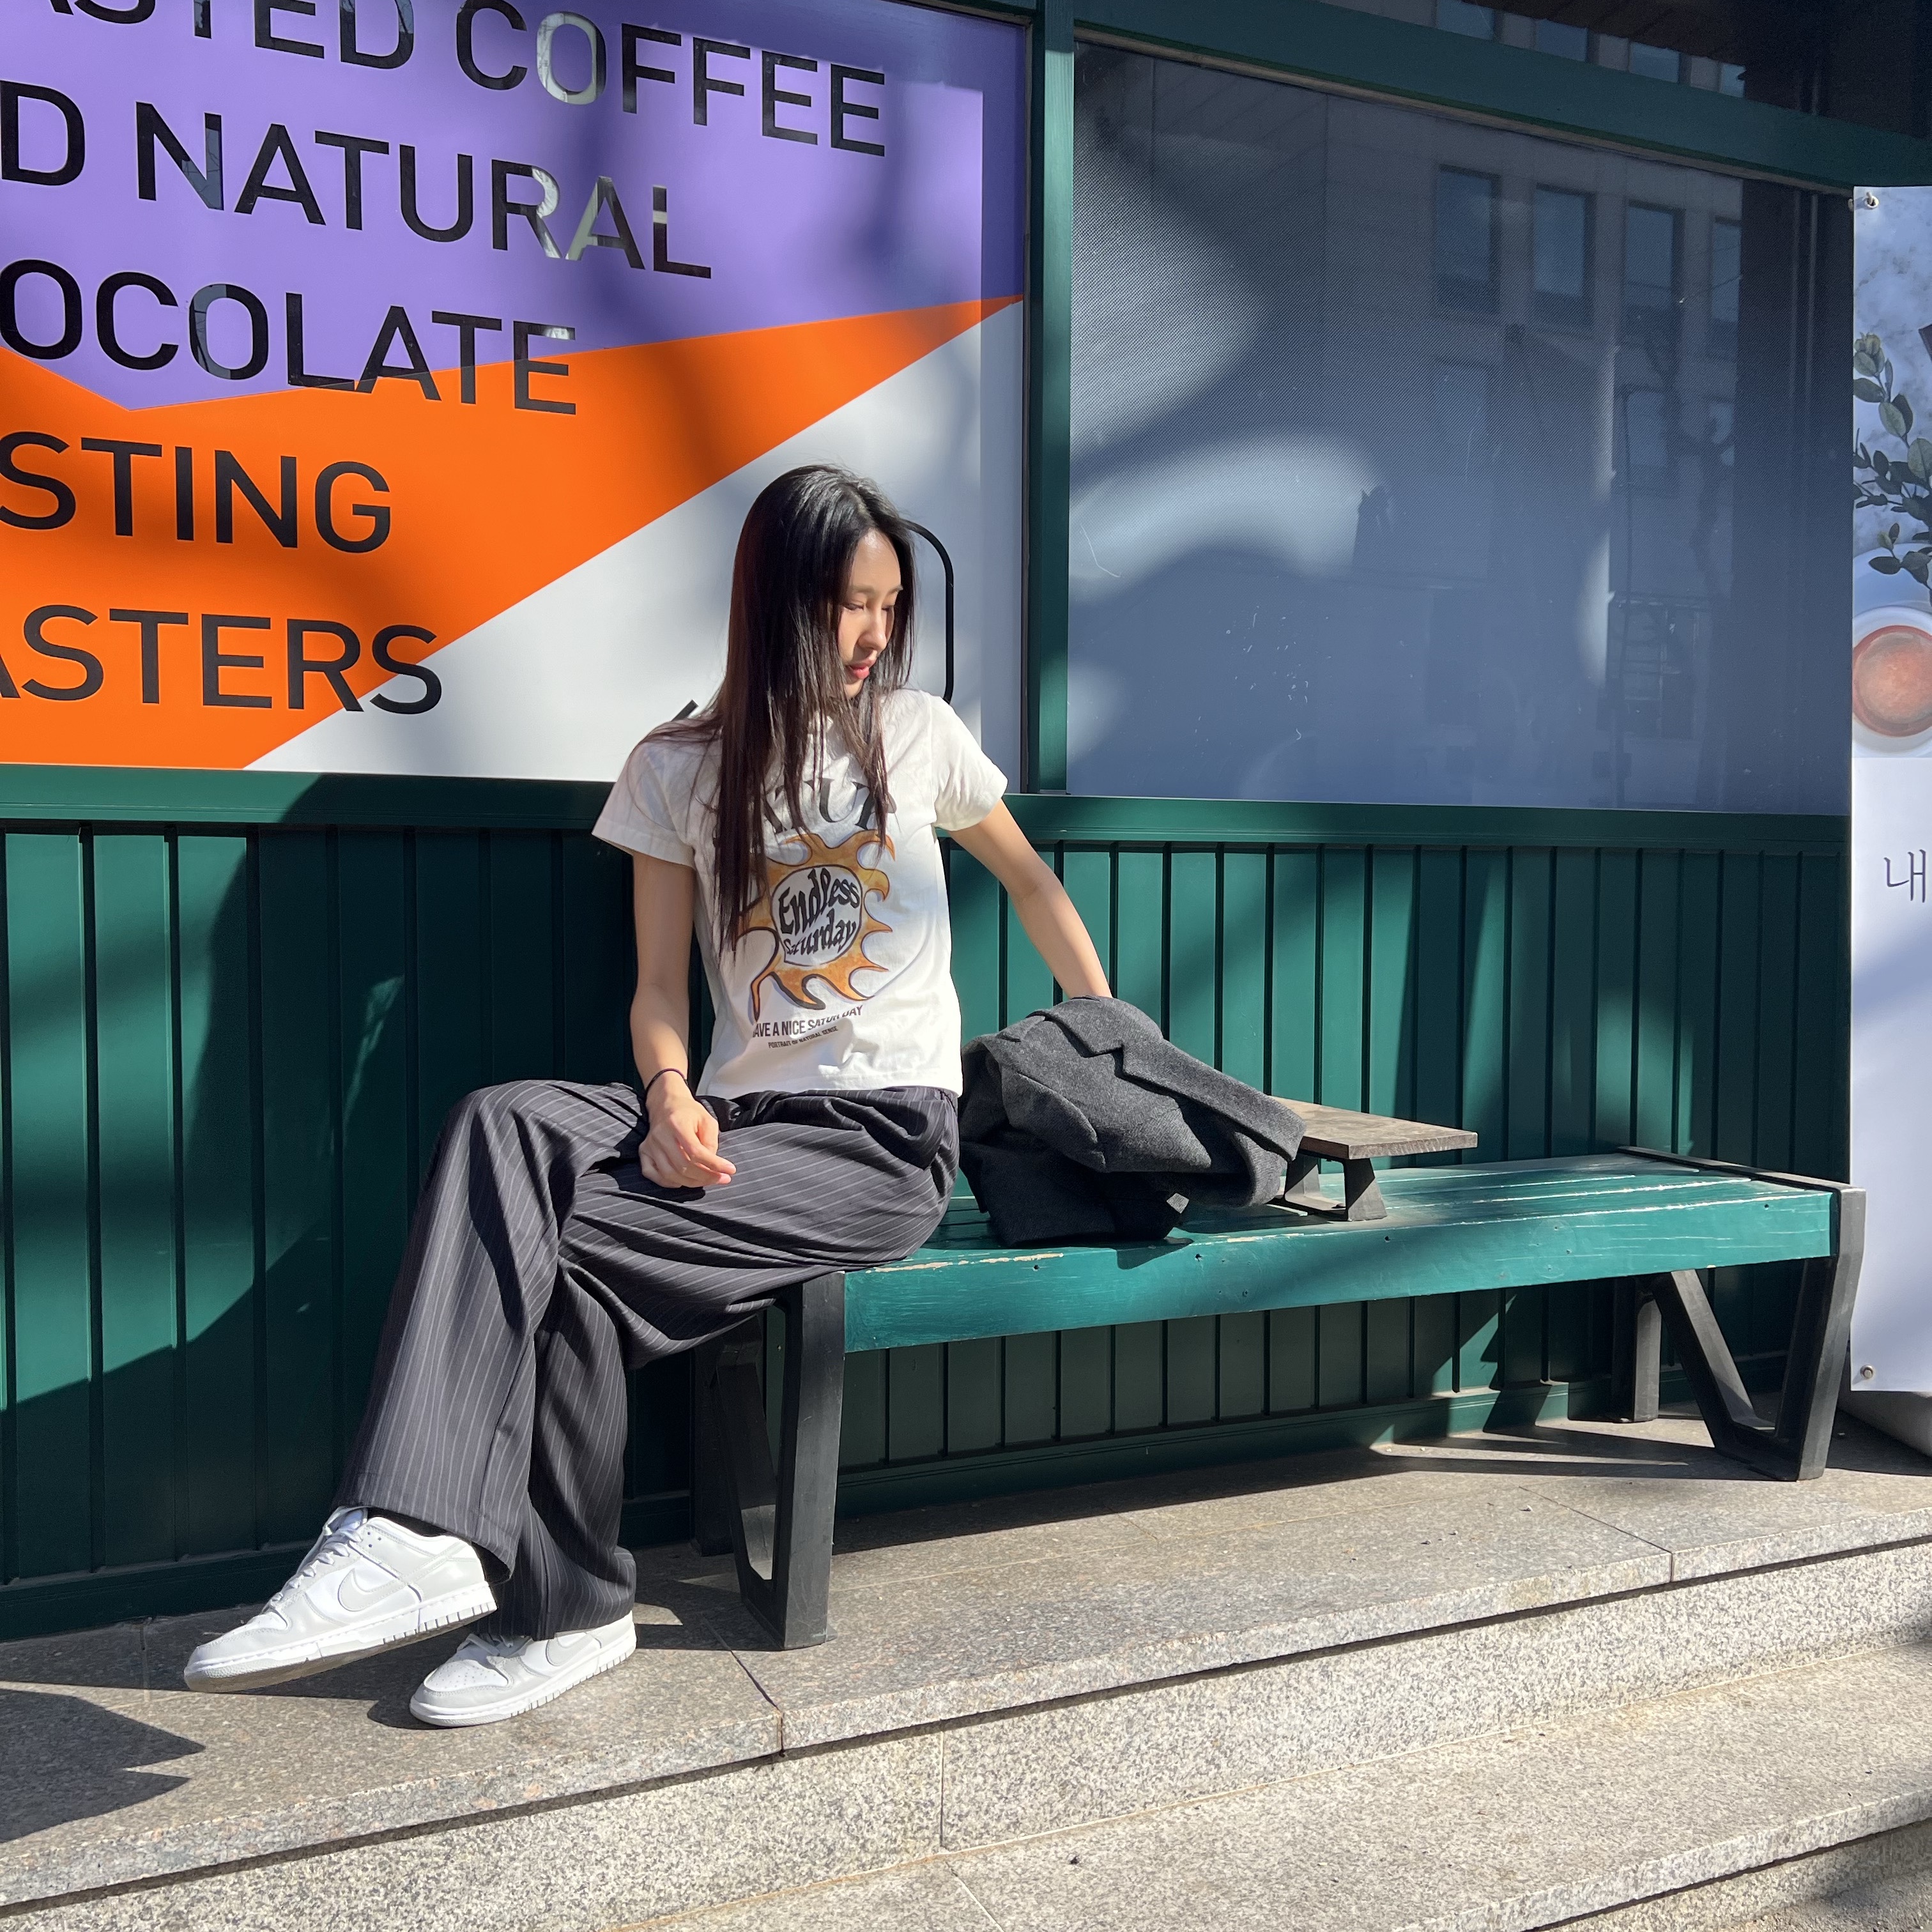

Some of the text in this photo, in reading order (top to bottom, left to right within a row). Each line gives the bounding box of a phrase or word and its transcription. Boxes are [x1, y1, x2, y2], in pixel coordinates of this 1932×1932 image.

[456, 0, 885, 157] COFFEE
[135, 101, 712, 280] NATURAL
[0, 258, 576, 415] OCOLATE
[0, 431, 392, 554] STING
[778, 867, 860, 937] Endless
[1883, 848, 1926, 903] 내
[772, 1022, 780, 1036] A
[781, 1020, 806, 1036] NICE
